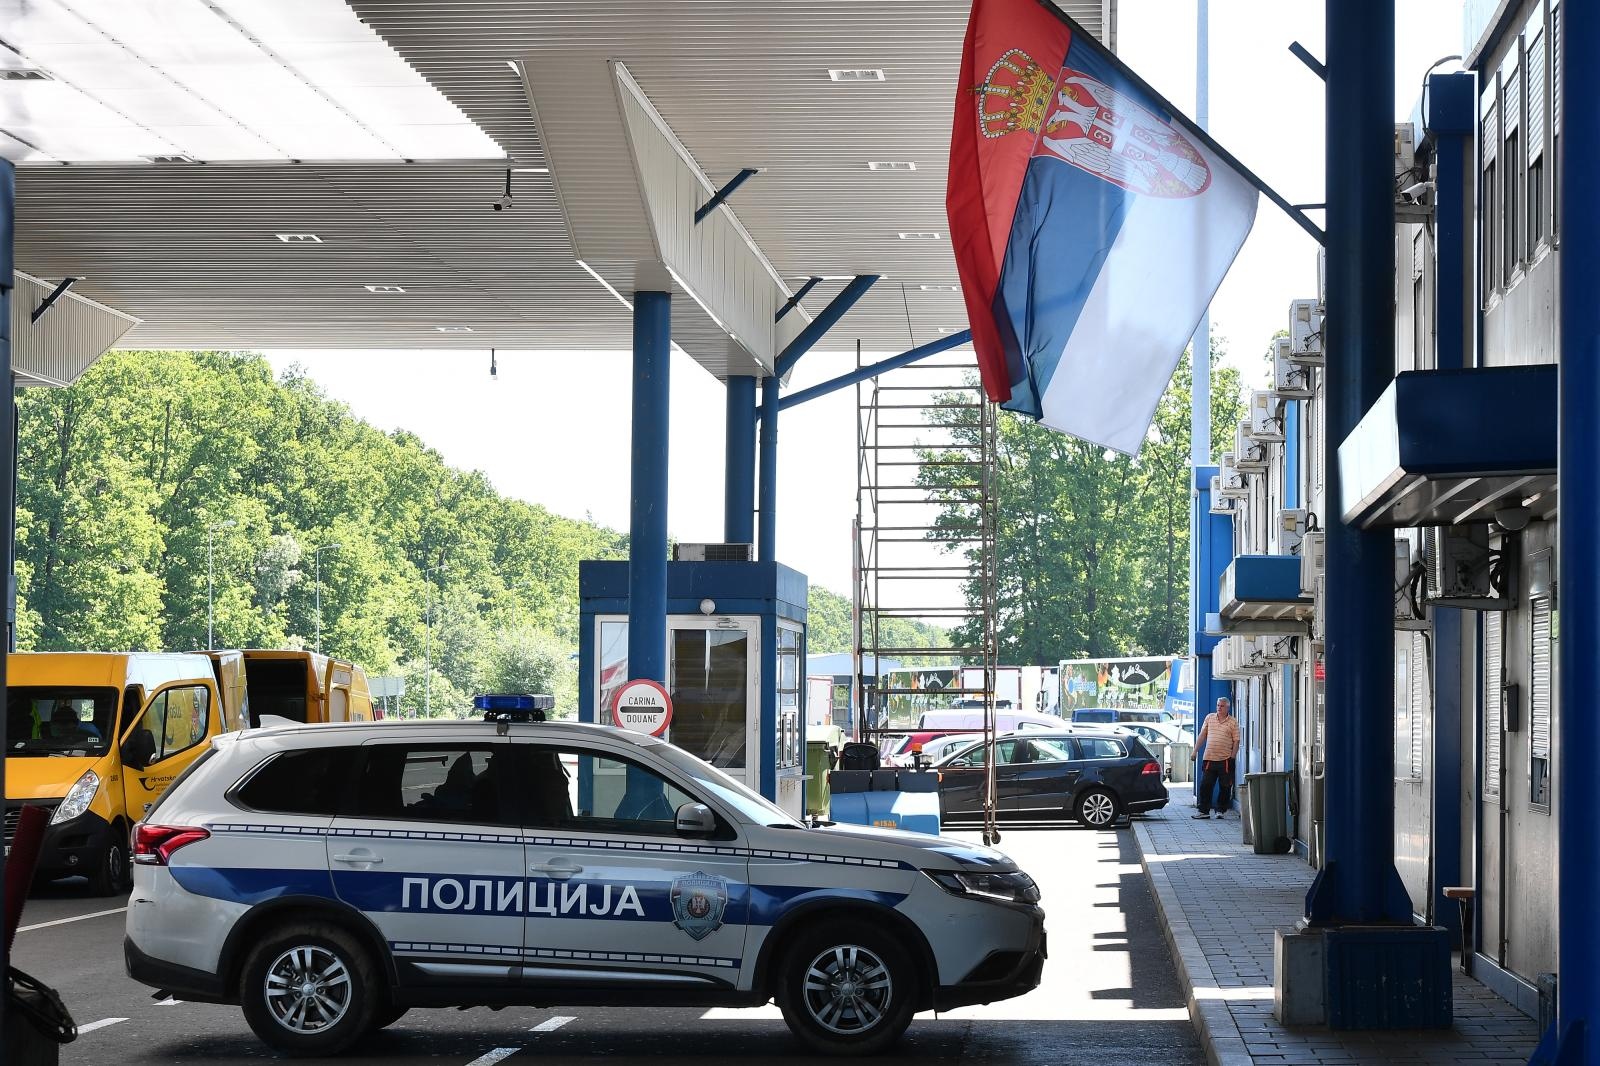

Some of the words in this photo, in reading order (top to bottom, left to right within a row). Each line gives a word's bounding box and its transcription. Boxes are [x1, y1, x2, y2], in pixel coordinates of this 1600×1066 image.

[628, 697, 656, 706] CARINA
[626, 715, 657, 723] DOUANE
[401, 877, 645, 917] ПОЛИЦИЈА
